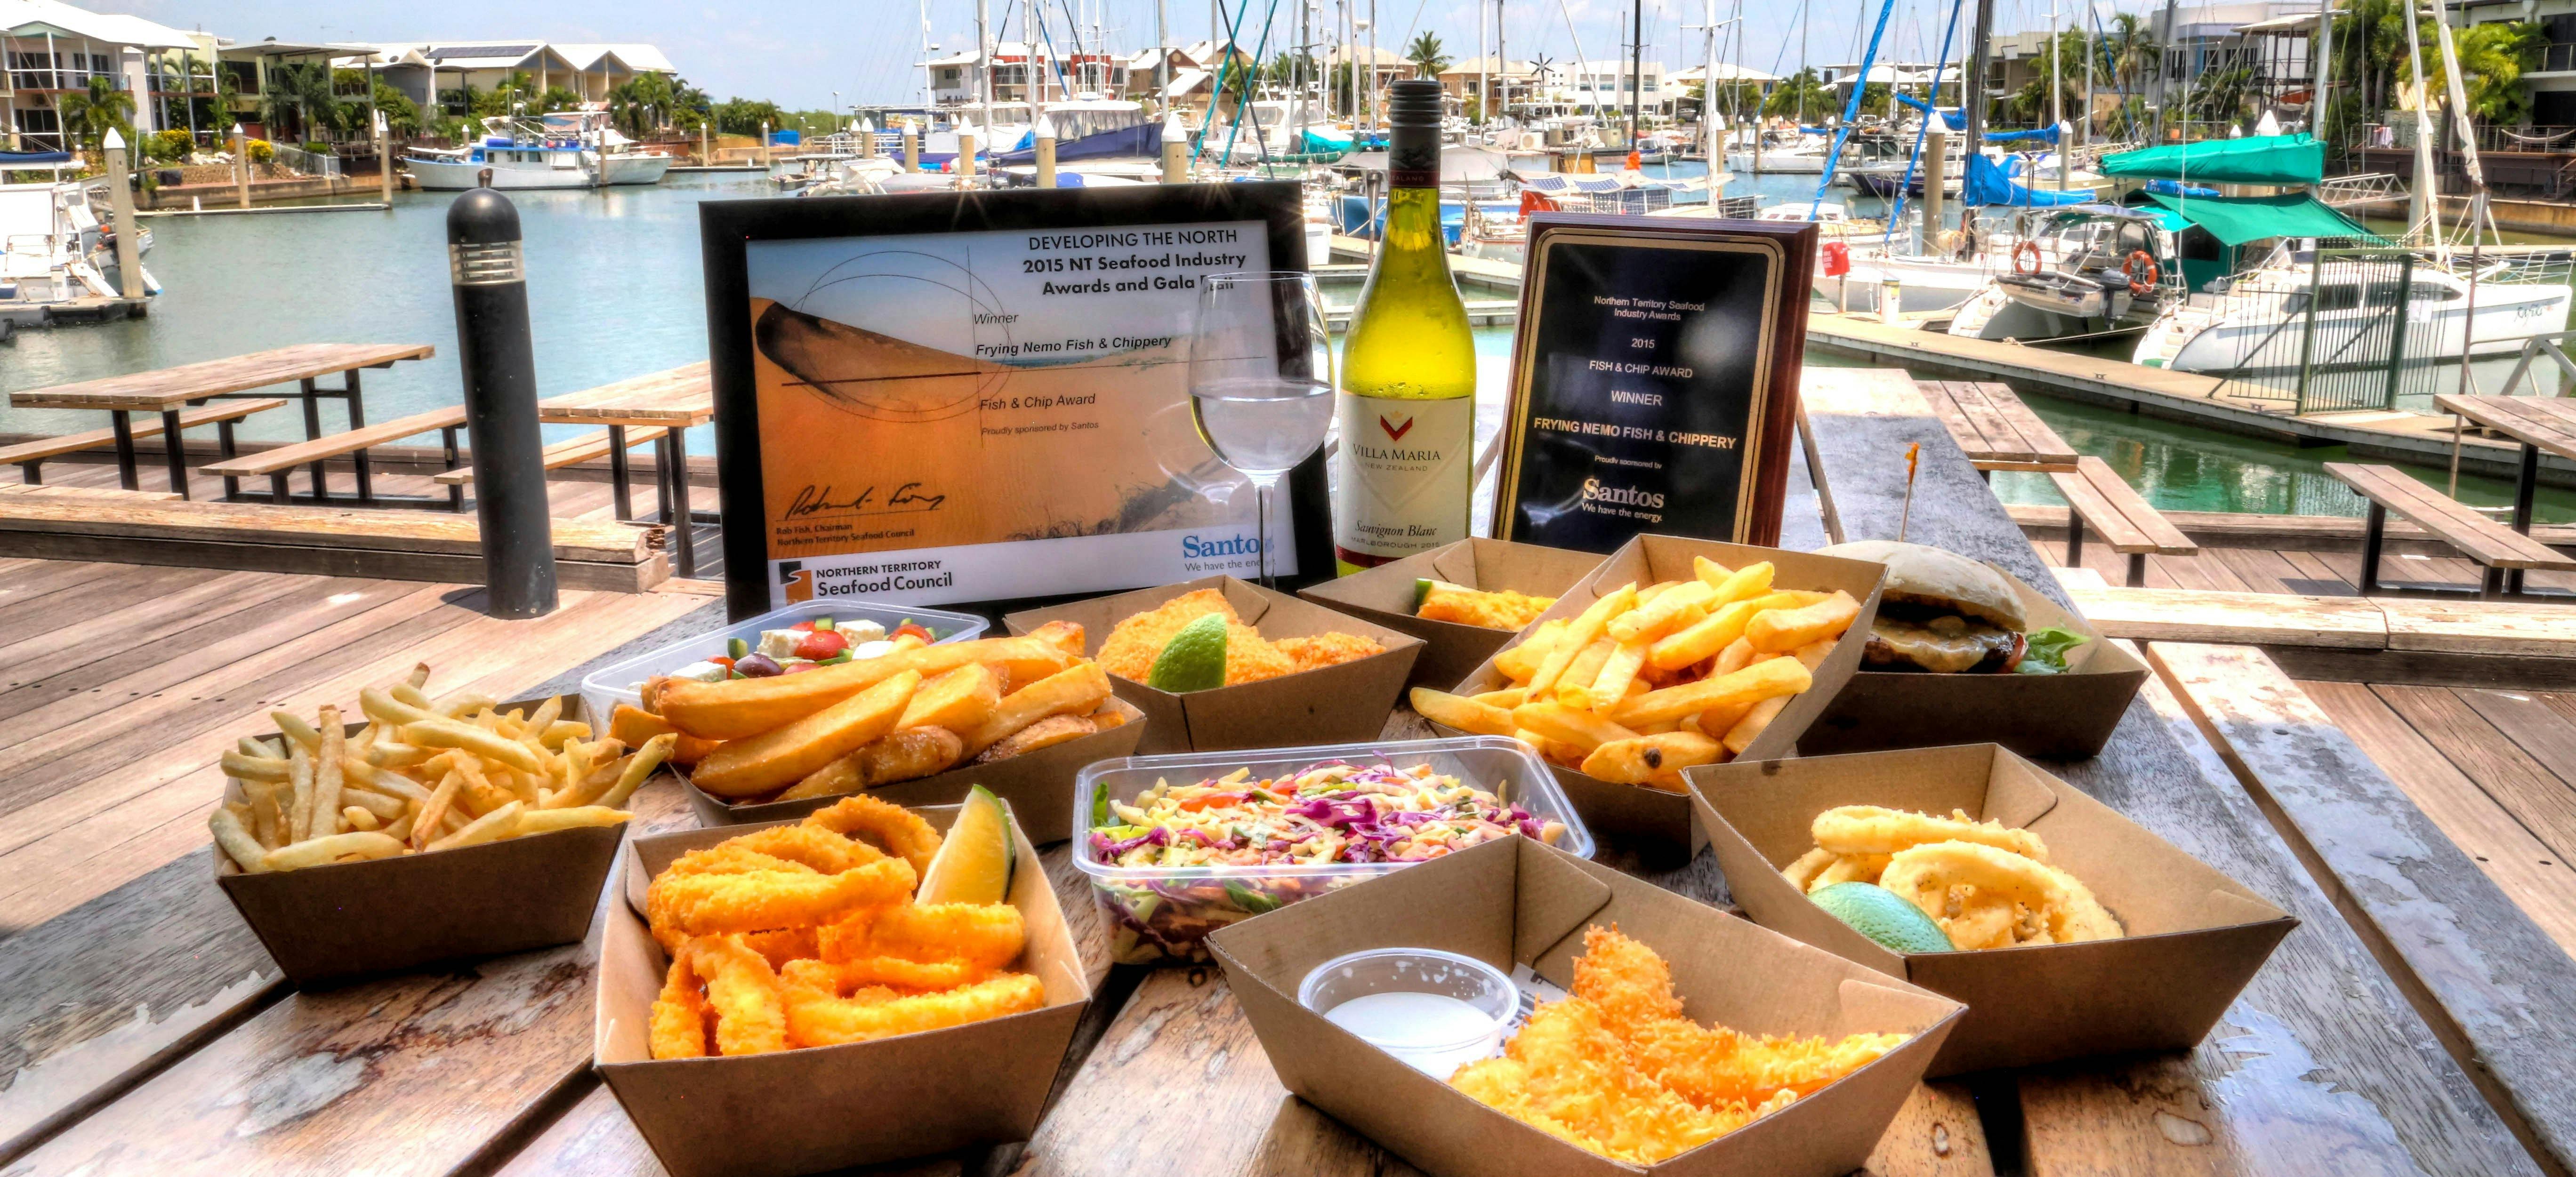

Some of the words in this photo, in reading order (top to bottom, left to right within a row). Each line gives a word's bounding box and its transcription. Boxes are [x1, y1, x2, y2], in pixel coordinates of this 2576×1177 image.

[1030, 233, 1138, 250] DEVELOPING
[1143, 232, 1173, 245] THE
[1178, 230, 1237, 244] NORTH
[1023, 259, 1063, 273] 2015
[1070, 257, 1092, 271] NT
[1099, 254, 1170, 270] Seafood
[1176, 252, 1246, 268] Industry
[1042, 279, 1110, 295] Awards
[1116, 276, 1148, 291] and
[1154, 275, 1194, 289] Gala
[1594, 296, 1629, 306] Northern
[1632, 298, 1666, 310] Territory
[1669, 301, 1705, 312] Seafood
[974, 313, 1019, 324] Winner
[1614, 308, 1647, 320] Industry
[1649, 311, 1681, 321] Awards
[976, 344, 1018, 357] Frying
[1023, 342, 1061, 353] Nemo
[1066, 339, 1094, 350] Fish
[1099, 338, 1107, 348] &
[1113, 336, 1171, 349] Chippery
[1631, 338, 1655, 348] 2015
[1589, 360, 1613, 371] FISH
[1615, 362, 1623, 372] &
[1625, 363, 1650, 374] CHIP
[1652, 366, 1693, 378] AWARD
[980, 398, 1006, 410] Fish
[1012, 398, 1020, 408] &
[1024, 397, 1052, 409] Chip
[1056, 394, 1095, 405] Award
[1611, 390, 1663, 407] WINNER
[982, 425, 1012, 435] Proudly
[1014, 424, 1057, 434] sponsored
[1059, 423, 1069, 432] by
[1071, 422, 1099, 430] Santos
[1534, 417, 1579, 433] FRYING
[1582, 422, 1620, 437] NEMO
[1623, 427, 1653, 441] FISH
[1656, 430, 1665, 442] &
[1668, 431, 1737, 449] CHIPPERY
[1353, 443, 1388, 459] VILLA
[1391, 448, 1441, 461] MARIA
[1594, 455, 1618, 464] Proudly
[1619, 459, 1653, 468] sponsored
[1583, 478, 1665, 508] Santos
[1582, 503, 1596, 513] We
[1598, 505, 1616, 516] have
[1618, 508, 1632, 518] the
[815, 523, 853, 532] Chairman
[1355, 520, 1403, 538] Sauvignon
[1408, 525, 1437, 537] Blanc
[777, 537, 814, 546] Northern
[815, 535, 849, 544] Territory
[851, 531, 884, 541] Seafood
[886, 529, 914, 538] Council
[1352, 536, 1417, 548] MARLBOROUGH
[816, 565, 878, 578] NORTHERN
[882, 560, 942, 573] TERRITORY
[1185, 563, 1202, 571] We
[1204, 561, 1224, 570] have
[1228, 560, 1242, 568] the
[818, 577, 891, 596] Seafood
[894, 572, 952, 590] Council
